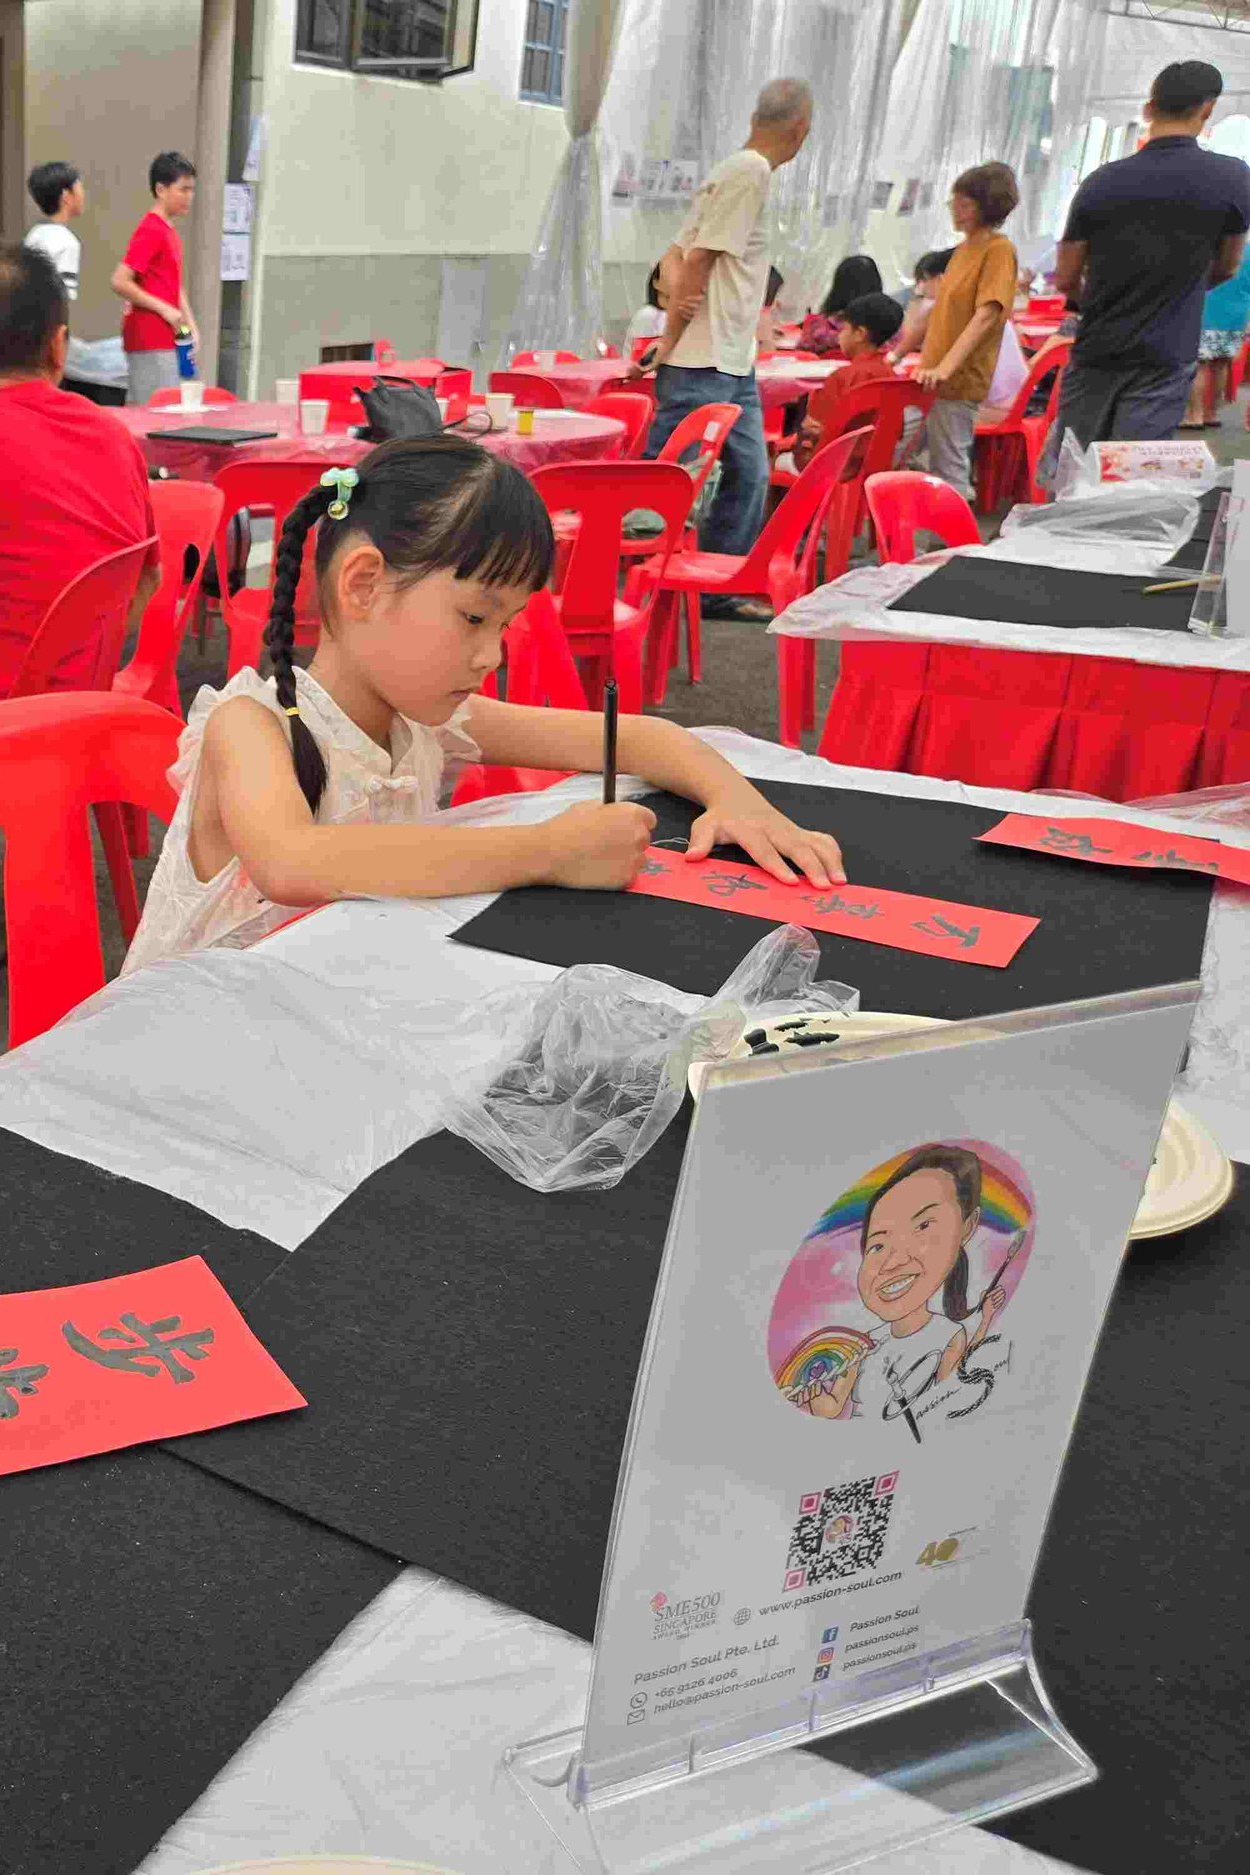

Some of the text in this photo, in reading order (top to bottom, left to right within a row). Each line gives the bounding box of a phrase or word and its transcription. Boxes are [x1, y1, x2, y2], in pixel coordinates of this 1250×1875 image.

[758, 1571, 902, 1616] www.passion-soul.com
[653, 1609, 717, 1635] SINGAPORE
[849, 1614, 892, 1632] Passion
[894, 1604, 920, 1621] Soul
[844, 1624, 920, 1653] passionsoul.ps
[633, 1634, 780, 1685] Passion Soul Pte. Ltd.
[653, 1667, 797, 1715] hello@passion-soul.com
